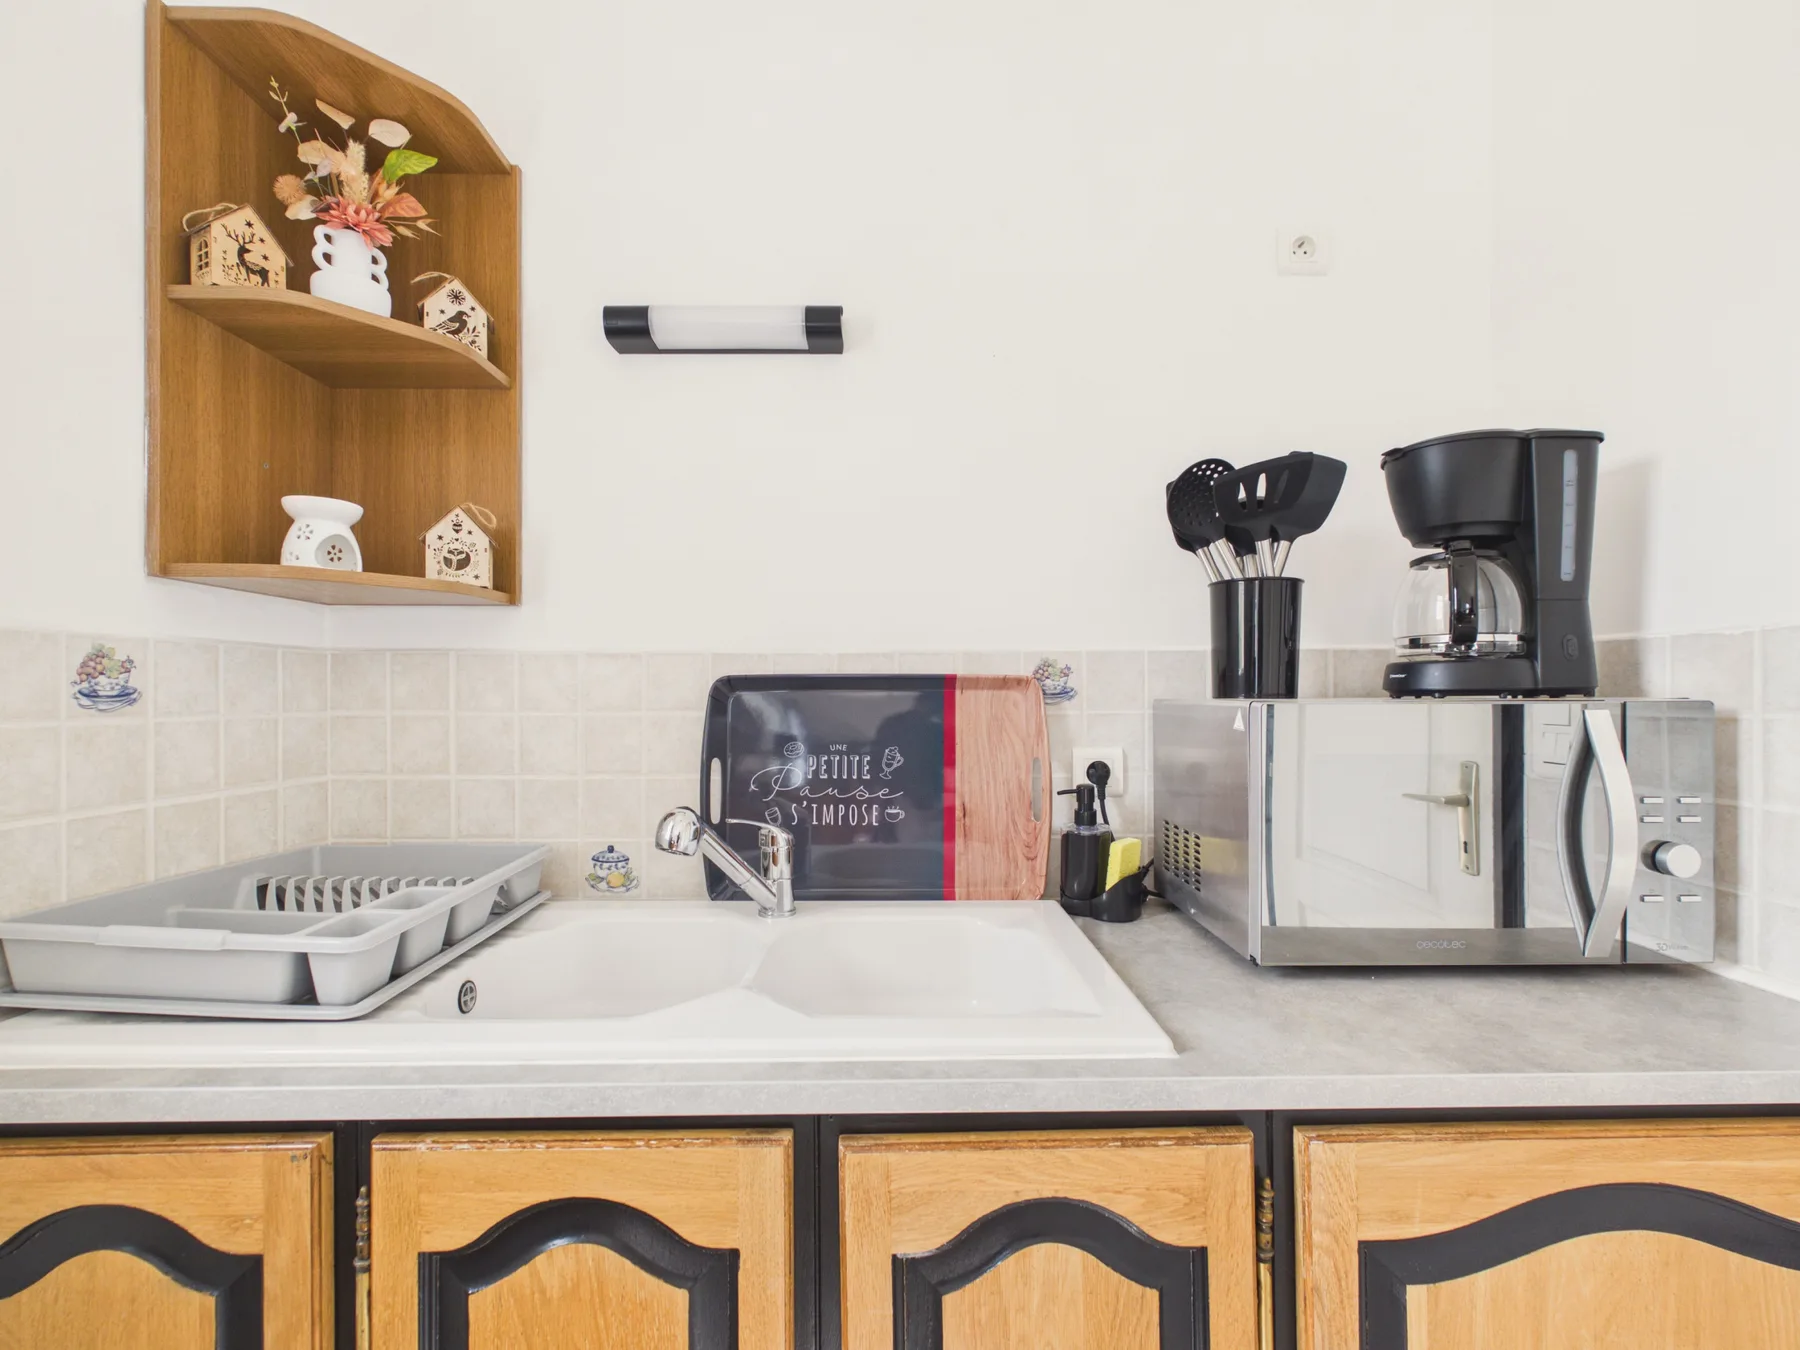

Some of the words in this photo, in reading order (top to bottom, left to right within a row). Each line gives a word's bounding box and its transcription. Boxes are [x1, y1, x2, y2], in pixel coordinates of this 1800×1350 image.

[830, 744, 848, 752] UNE
[807, 755, 871, 779] PETITE
[749, 763, 904, 801] Pause
[791, 800, 879, 826] S'IMPOSE
